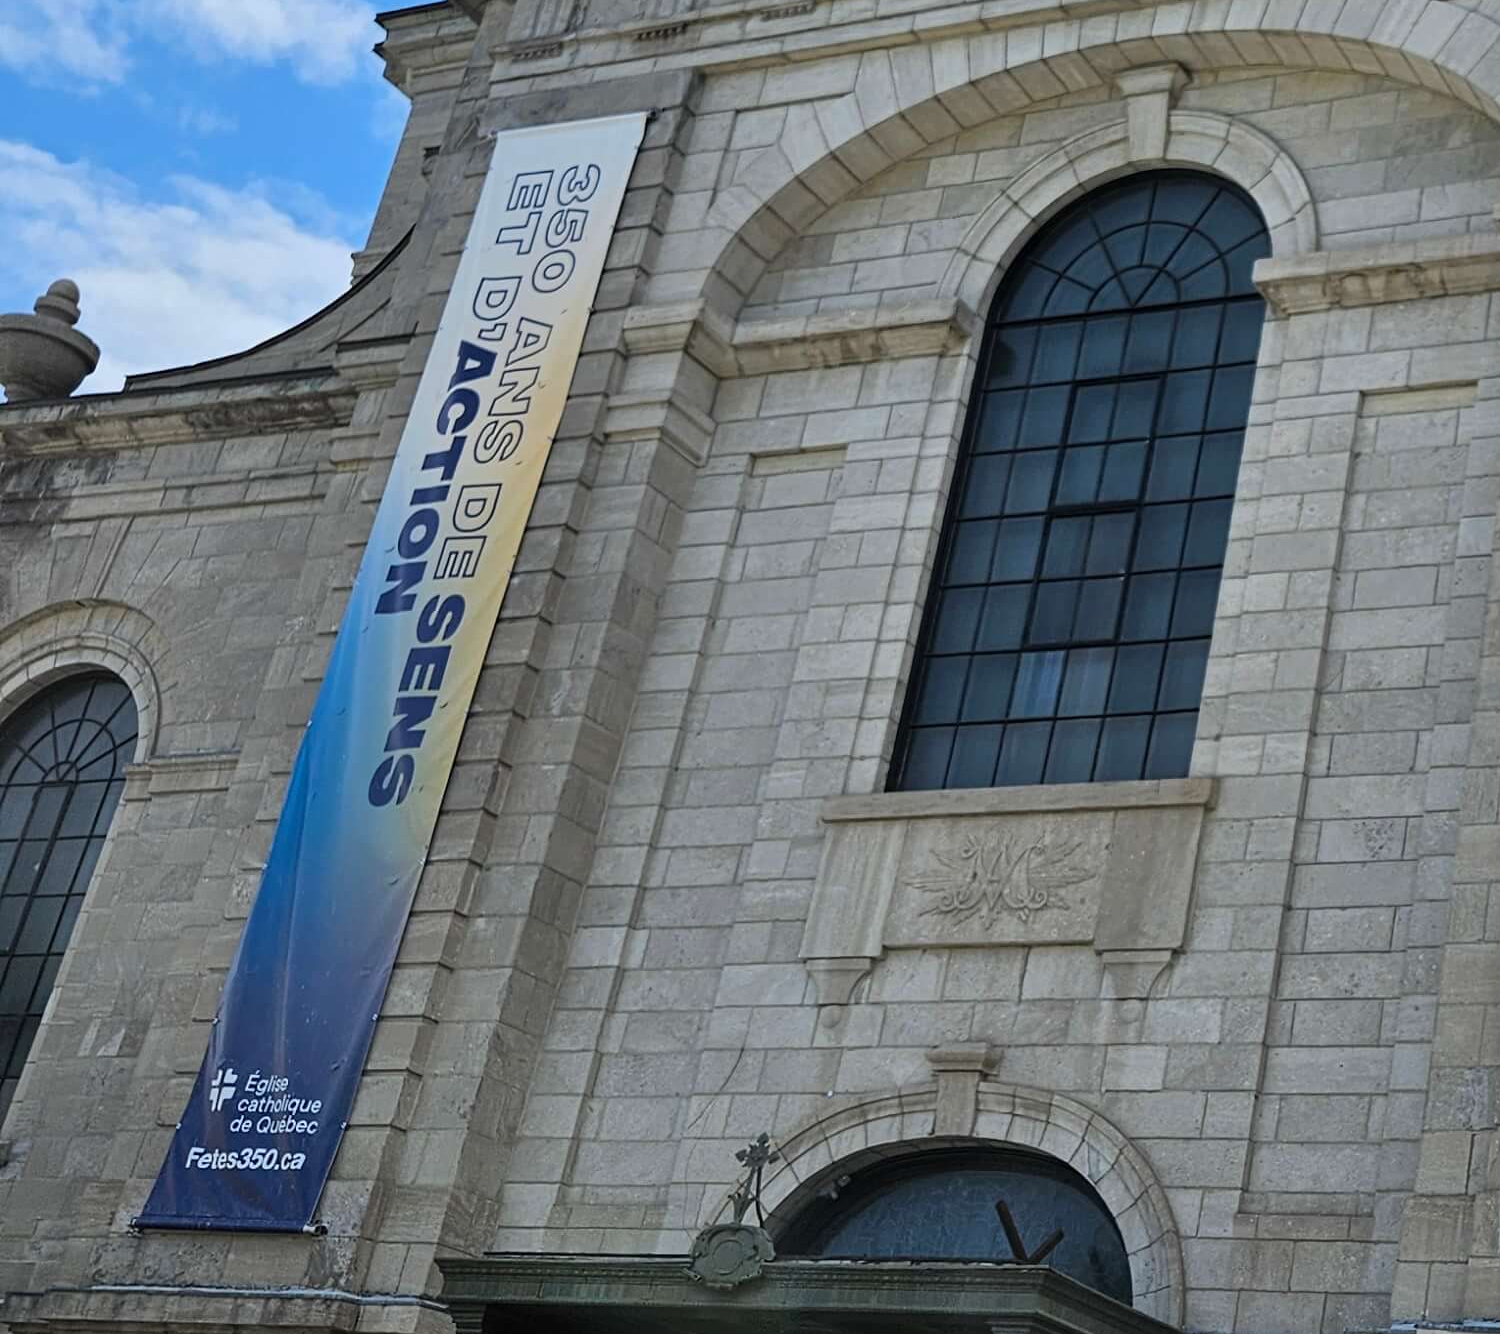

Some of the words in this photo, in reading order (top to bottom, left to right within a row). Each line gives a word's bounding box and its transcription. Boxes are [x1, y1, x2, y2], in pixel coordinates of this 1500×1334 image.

[496, 171, 554, 255] ET
[532, 163, 600, 293] 350
[475, 318, 554, 465] ANS
[374, 277, 522, 615] D'ACTION
[434, 485, 502, 581] DE
[367, 593, 466, 809] SENS
[230, 1115, 251, 1133] de
[256, 1116, 319, 1135] Québec
[237, 1095, 322, 1116] catholique
[245, 1070, 289, 1096] Église
[185, 1147, 306, 1170] Fetes350.ca
